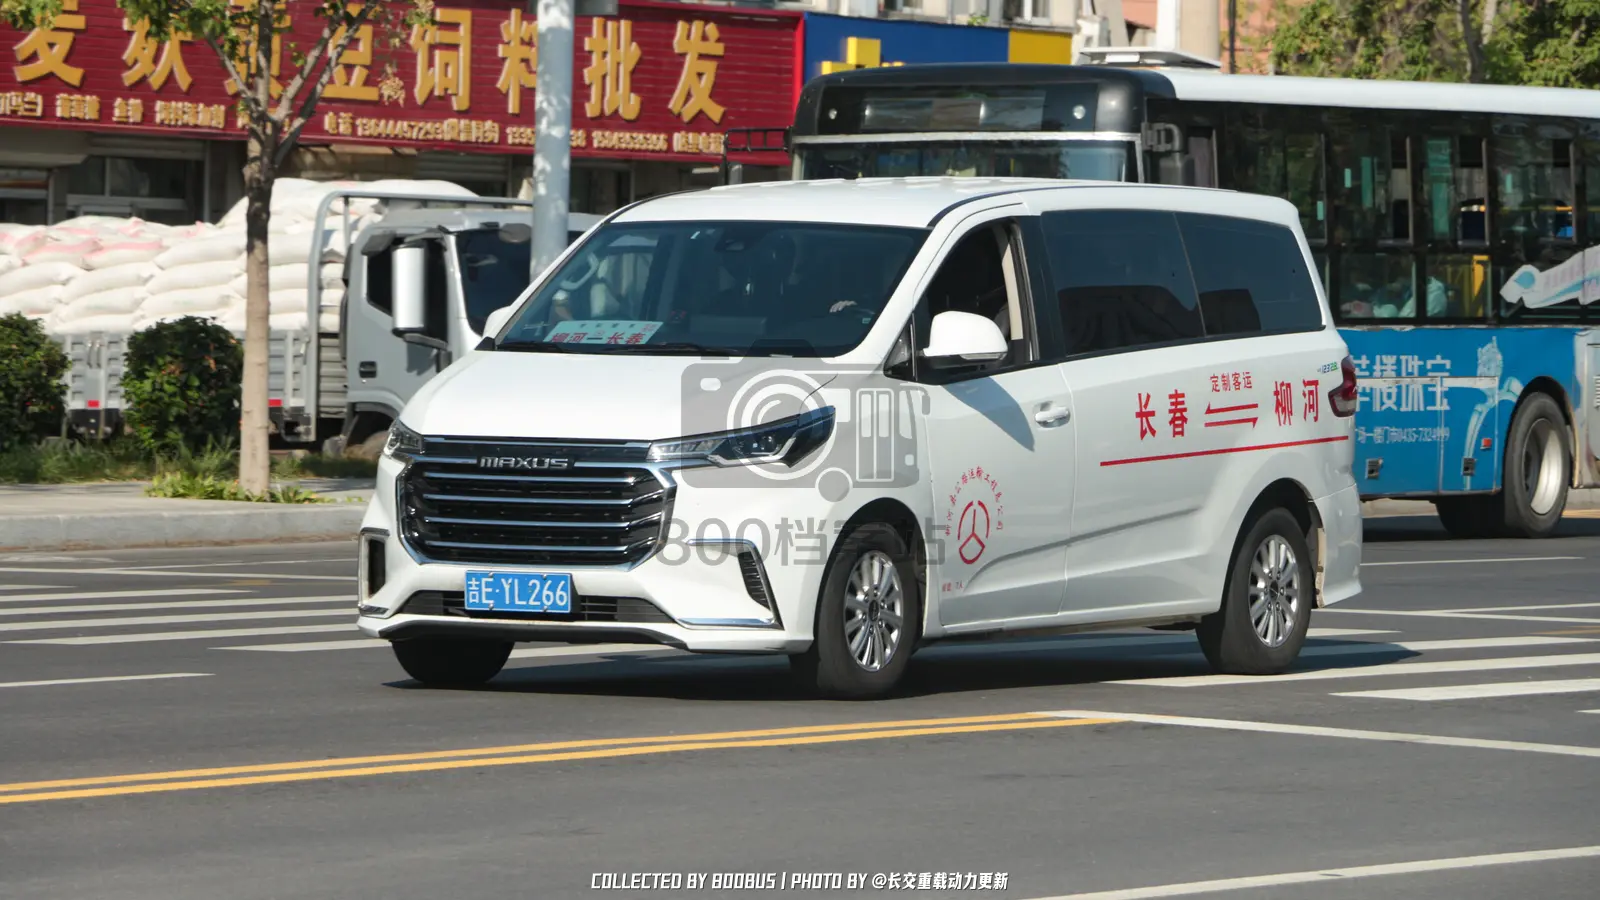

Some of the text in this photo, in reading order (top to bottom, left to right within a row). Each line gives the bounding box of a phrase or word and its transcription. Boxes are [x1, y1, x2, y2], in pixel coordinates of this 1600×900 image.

[1210, 371, 1253, 392] 定制客运
[1135, 378, 1320, 440] 长春 柳河
[479, 456, 569, 469] MAXUS
